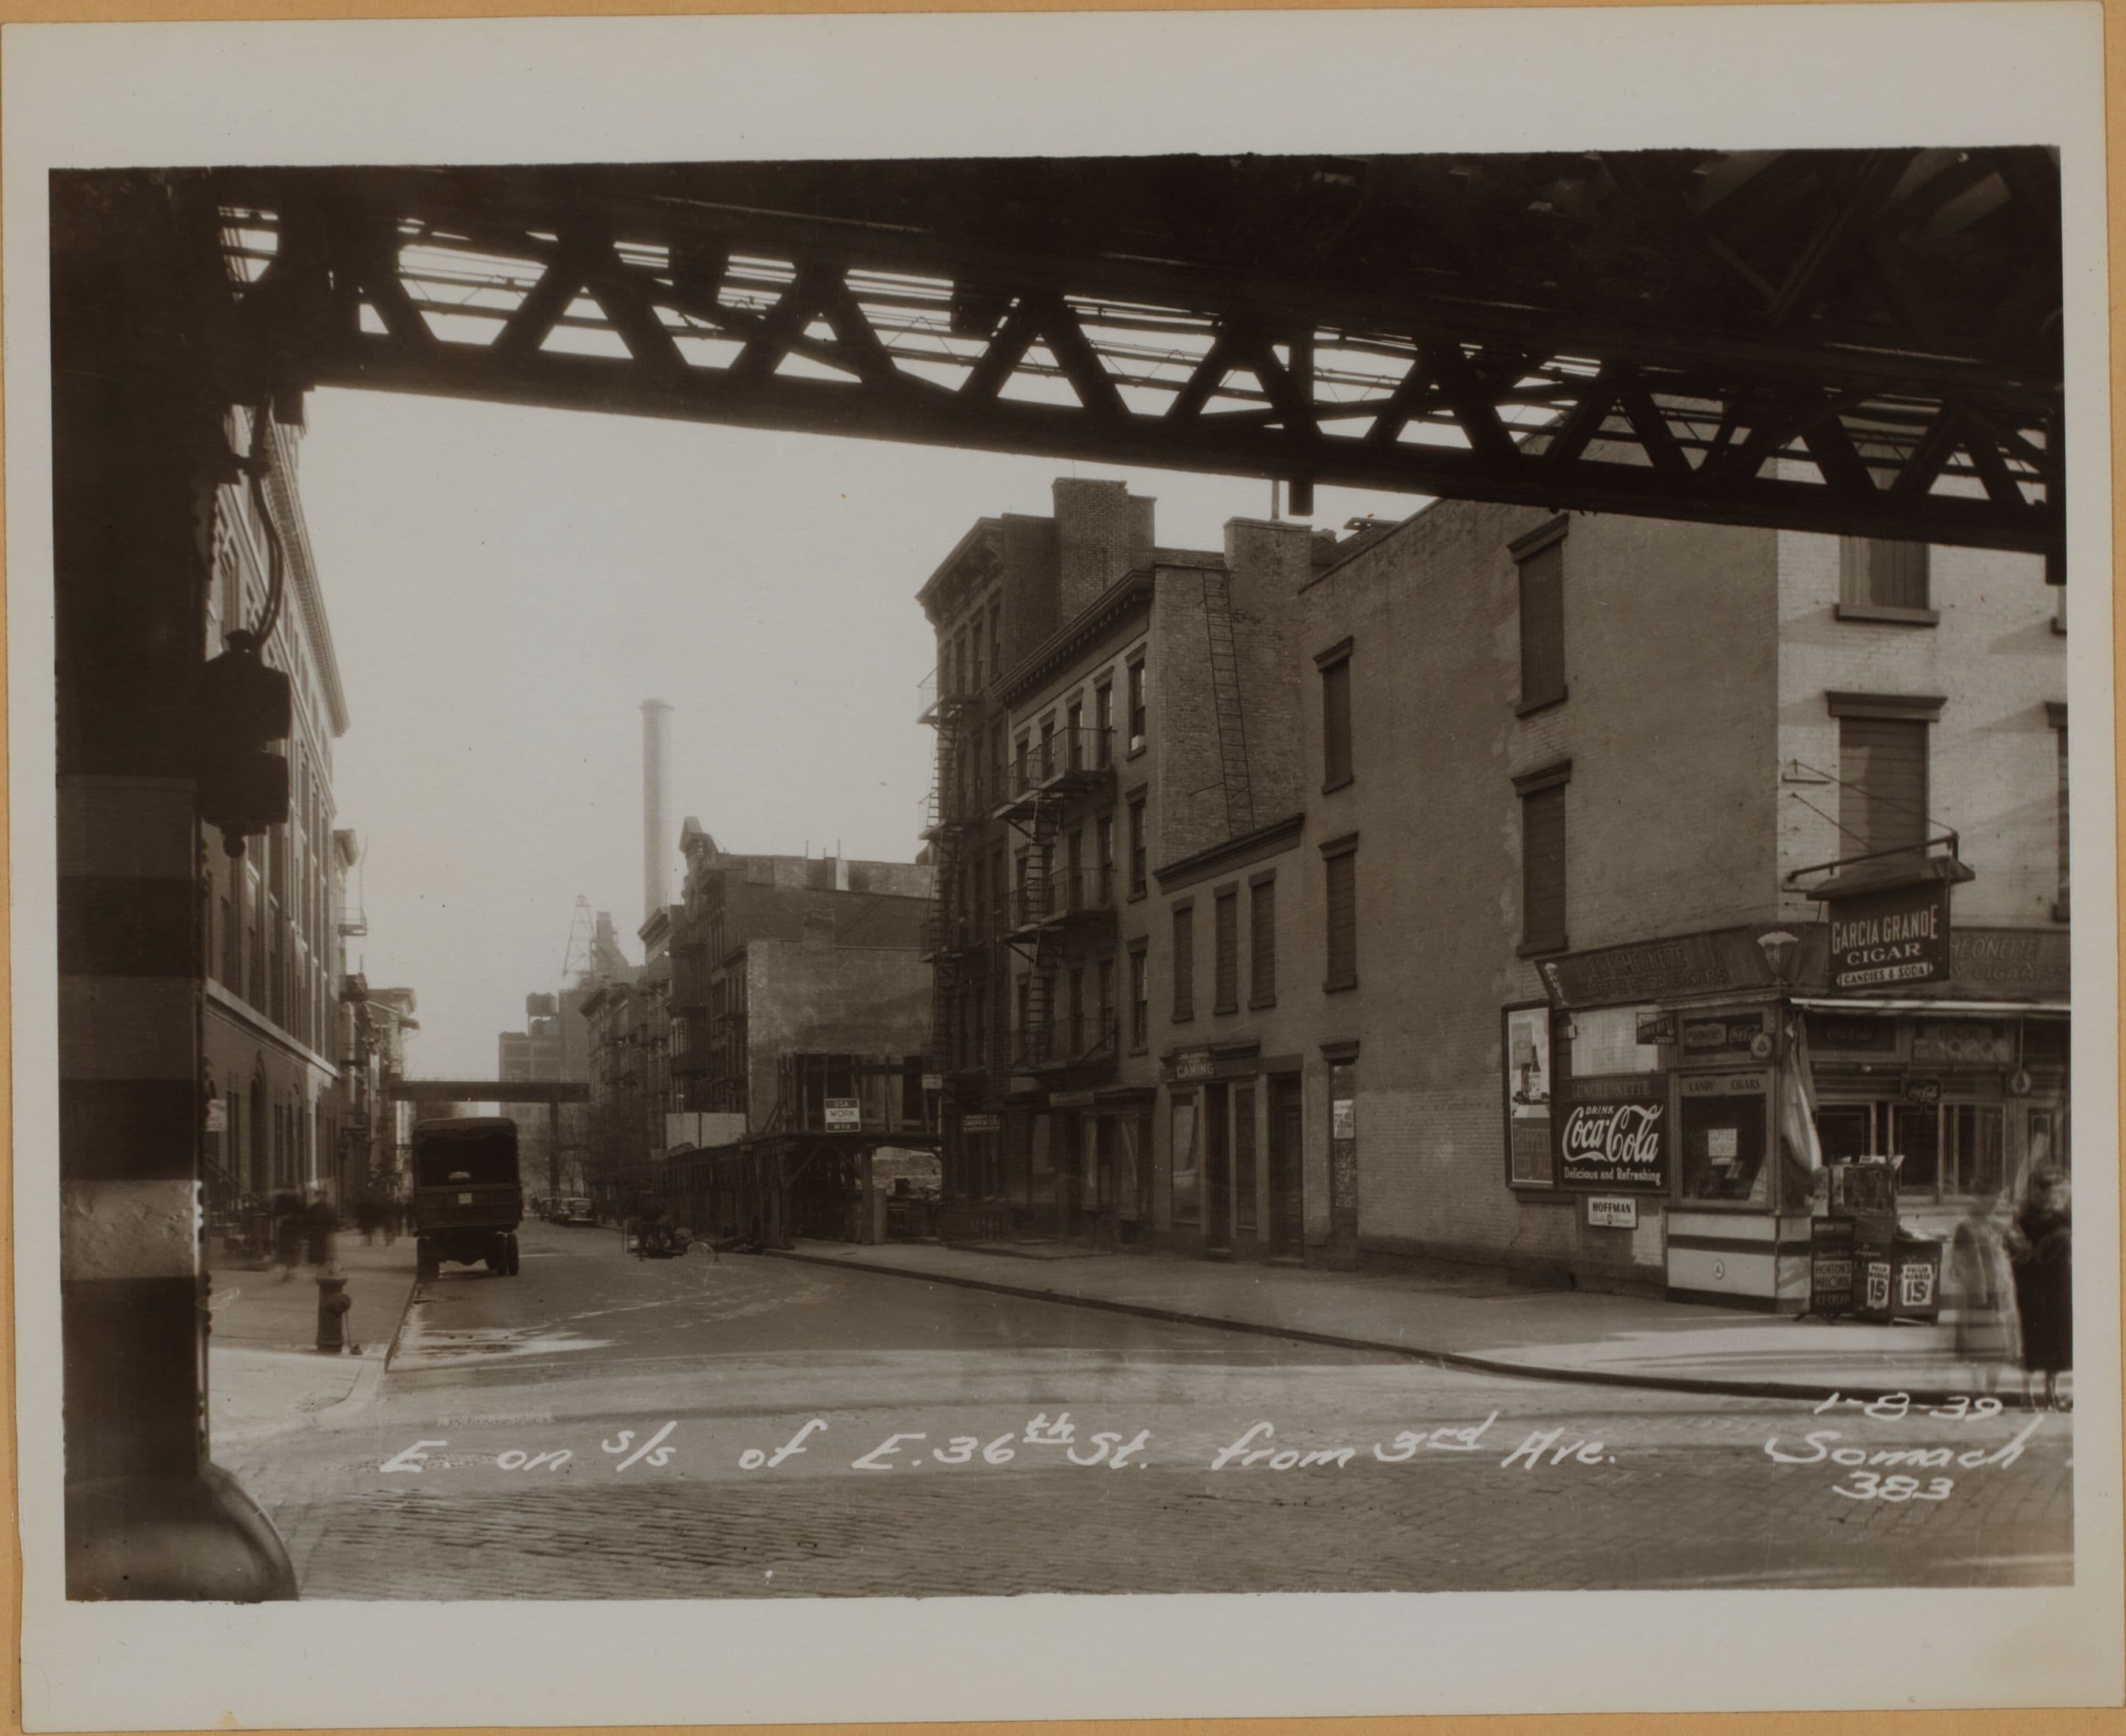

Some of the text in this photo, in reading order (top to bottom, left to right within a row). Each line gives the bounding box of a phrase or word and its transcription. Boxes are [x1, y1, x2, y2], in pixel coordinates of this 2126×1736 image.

[1832, 904, 1938, 955] GARCIA GRANDE
[1847, 942, 1922, 965] CIGAR
[1845, 970, 1884, 984] CANDIES
[1899, 965, 1925, 977] SODA
[1731, 1079, 1760, 1091] CIGARS
[1585, 1106, 1615, 1115] DRINK
[1564, 1167, 1661, 1186] Delicious and Refreshing
[1593, 1202, 1631, 1213] HOFFMAN
